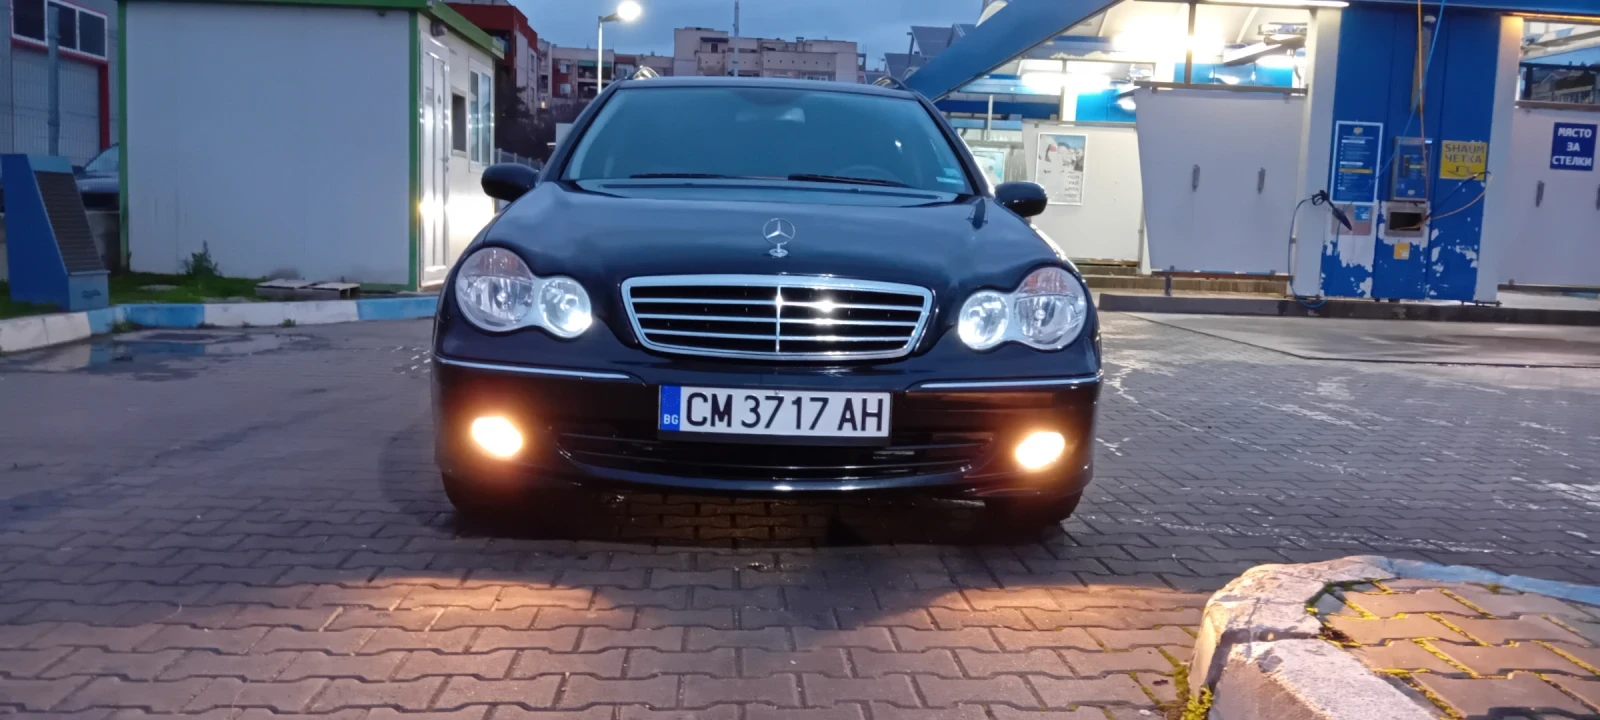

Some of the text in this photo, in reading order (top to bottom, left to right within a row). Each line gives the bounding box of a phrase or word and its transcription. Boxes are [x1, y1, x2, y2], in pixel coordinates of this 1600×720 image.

[1558, 127, 1592, 138] МЯСТО
[1566, 142, 1580, 152] ЗА
[1445, 153, 1482, 163] ЧЕТКА
[1552, 155, 1592, 166] СТЕЛКИ
[663, 392, 883, 431] BG CM 3717 AH
